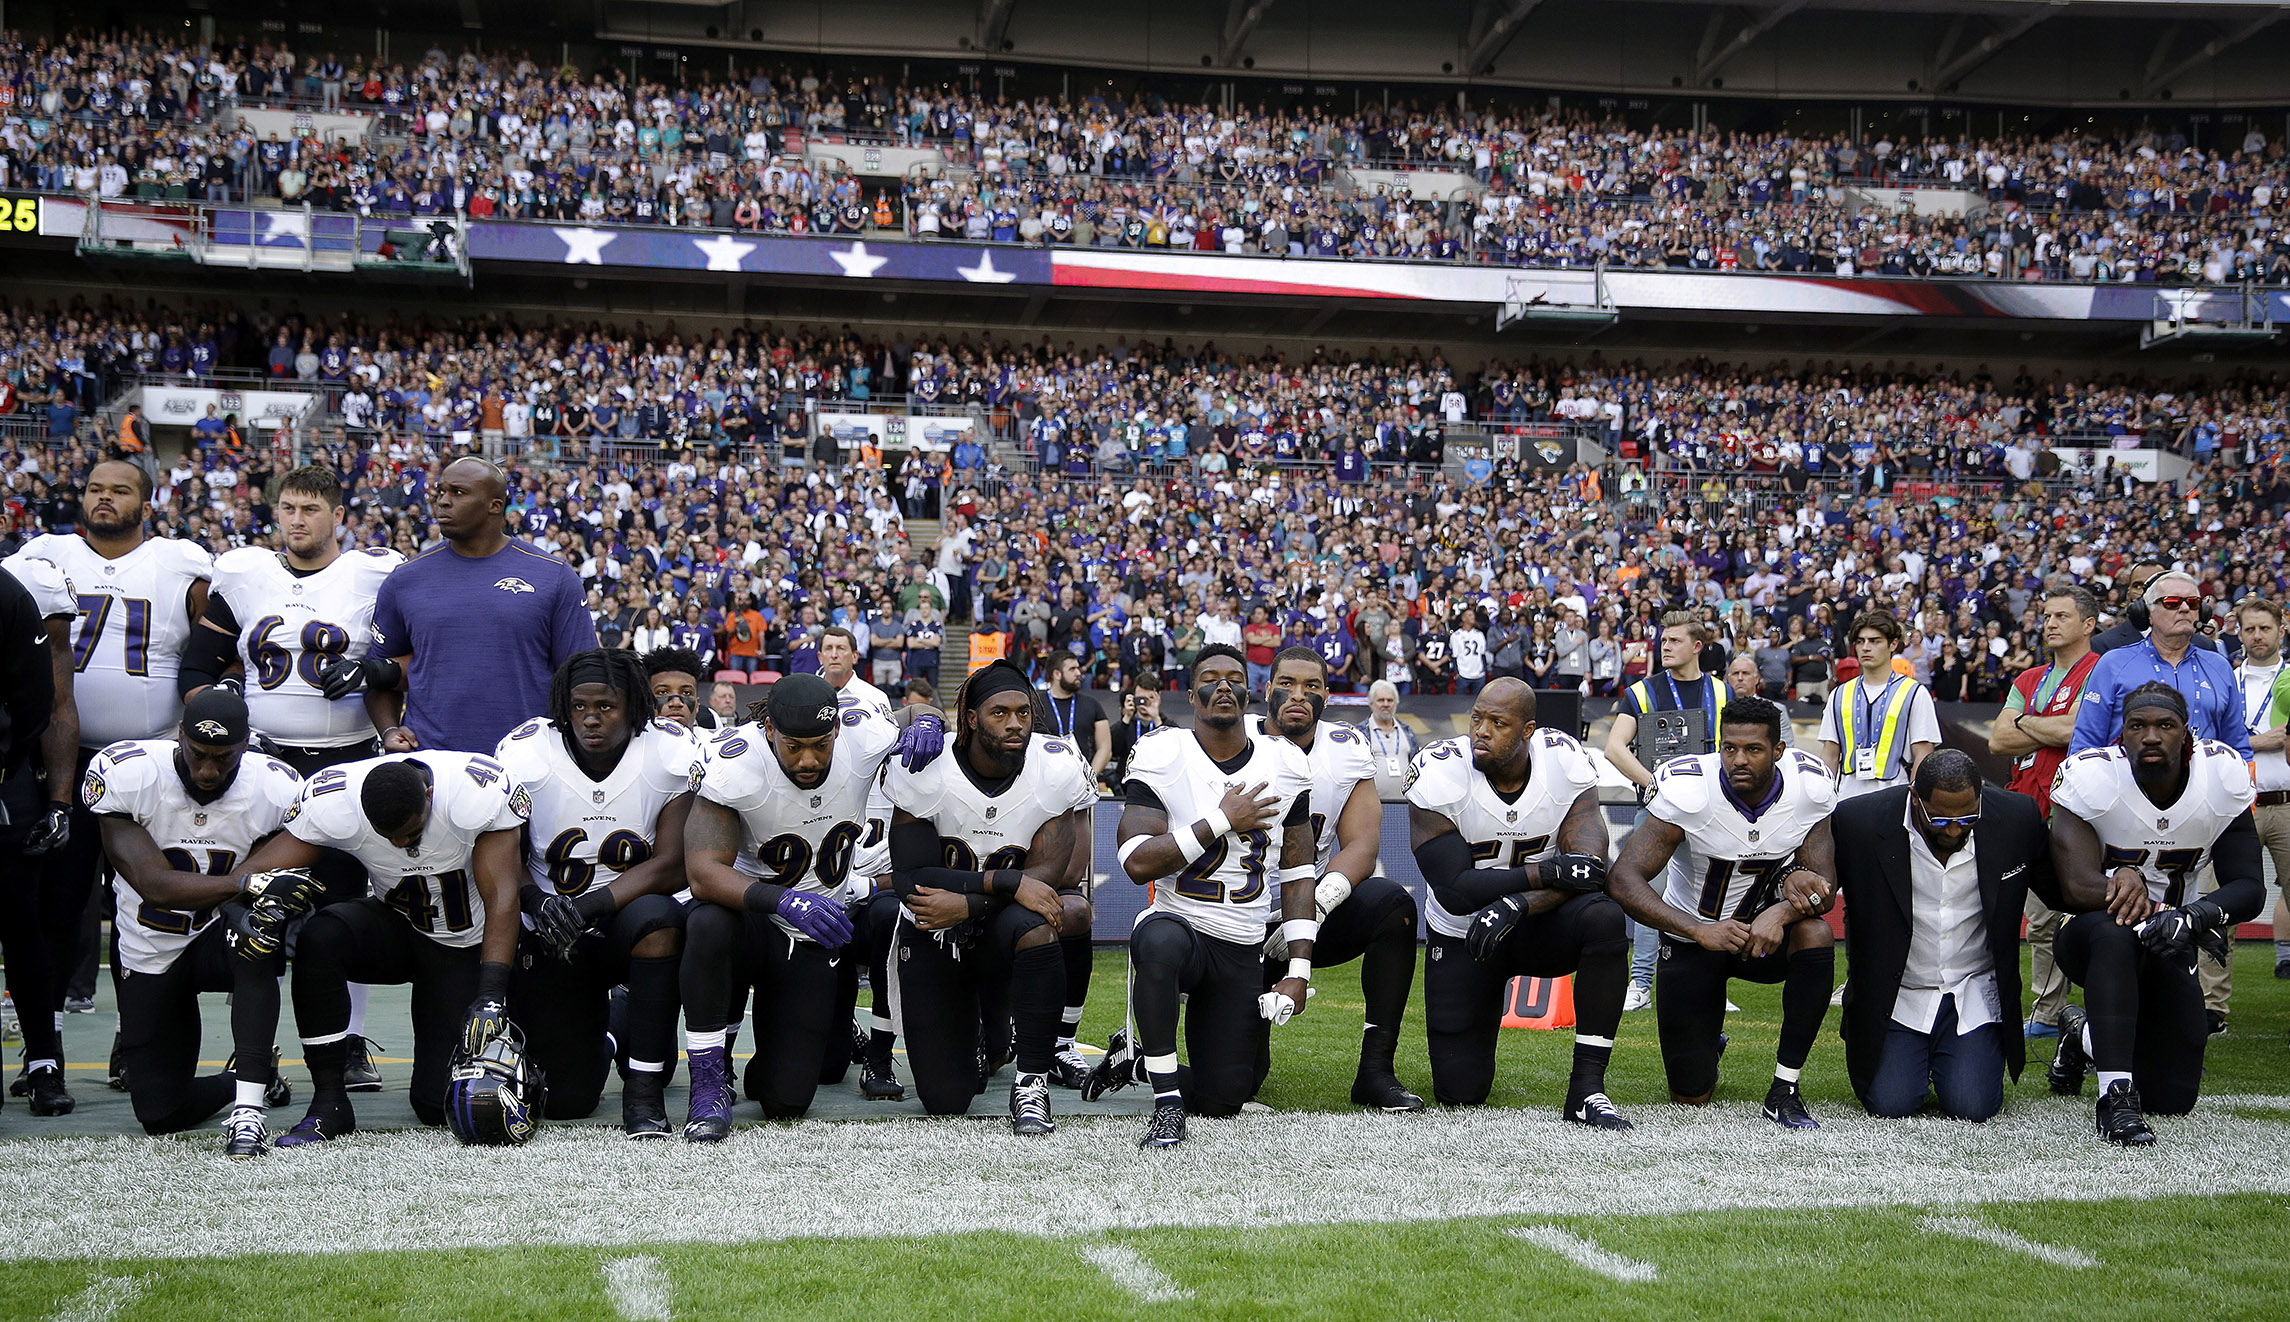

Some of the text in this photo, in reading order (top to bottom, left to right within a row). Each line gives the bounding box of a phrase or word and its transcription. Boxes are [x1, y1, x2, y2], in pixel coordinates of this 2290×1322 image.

[0, 199, 37, 232] 25
[638, 203, 651, 216] 12
[922, 381, 934, 392] 92
[1450, 397, 1461, 407] 58
[888, 422, 906, 433] 124
[1665, 429, 1672, 442] 5
[1727, 436, 1735, 447] 7
[1679, 446, 1687, 457] 5
[1763, 447, 1774, 458] 10
[1809, 451, 1820, 462] 10
[1344, 455, 1353, 469] 5
[530, 514, 548, 530] 57
[1951, 525, 1959, 537] 5
[94, 585, 125, 593] RAVENS
[285, 603, 316, 613] RAVENS
[1432, 600, 1444, 614] 18
[75, 594, 151, 677] 71
[683, 632, 699, 650] 57
[247, 615, 350, 691] 68
[1324, 642, 1341, 659] 51
[1425, 643, 1444, 659] 27
[1464, 644, 1478, 656] 52
[102, 741, 147, 765] 21
[1428, 738, 1464, 761] 55
[465, 756, 504, 788] 41
[1668, 757, 1704, 777] 17
[1798, 752, 1825, 777] 17
[313, 769, 347, 797] 41
[803, 814, 833, 825] RAVENS
[972, 829, 1004, 837] RAVENS
[545, 827, 652, 895] 69
[758, 820, 863, 889] 90
[401, 865, 435, 873] RAVENS
[1175, 828, 1272, 904] 23
[1698, 856, 1783, 922] 17
[383, 868, 475, 934] 41
